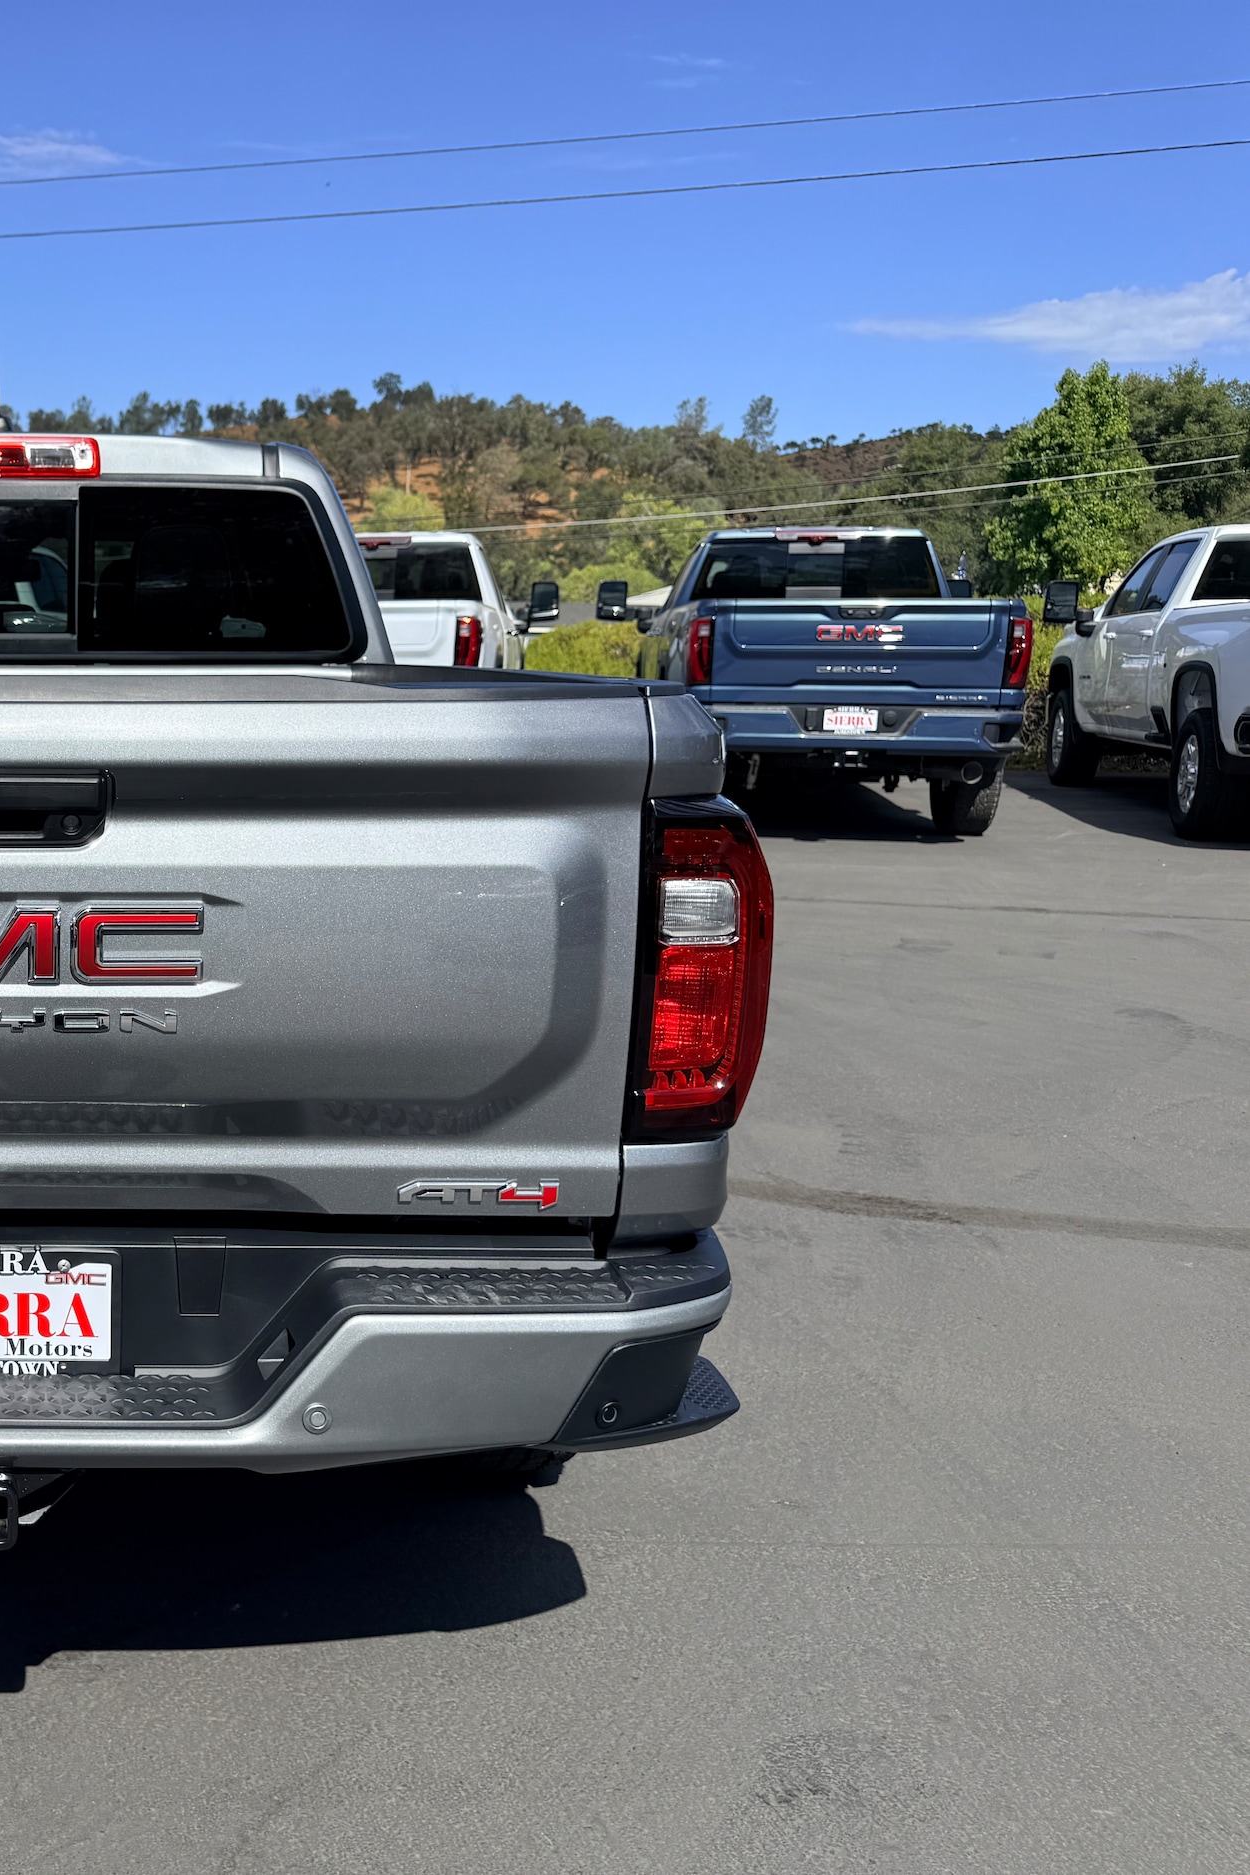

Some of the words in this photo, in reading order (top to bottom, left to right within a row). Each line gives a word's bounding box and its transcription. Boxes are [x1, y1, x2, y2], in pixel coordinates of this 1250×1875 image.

[816, 625, 905, 641] GMC
[816, 665, 897, 674] DENALI
[826, 715, 874, 727] SIERRA
[397, 1178, 560, 1211] AT4
[43, 1271, 107, 1287] GMC
[3, 1337, 94, 1358] Motors
